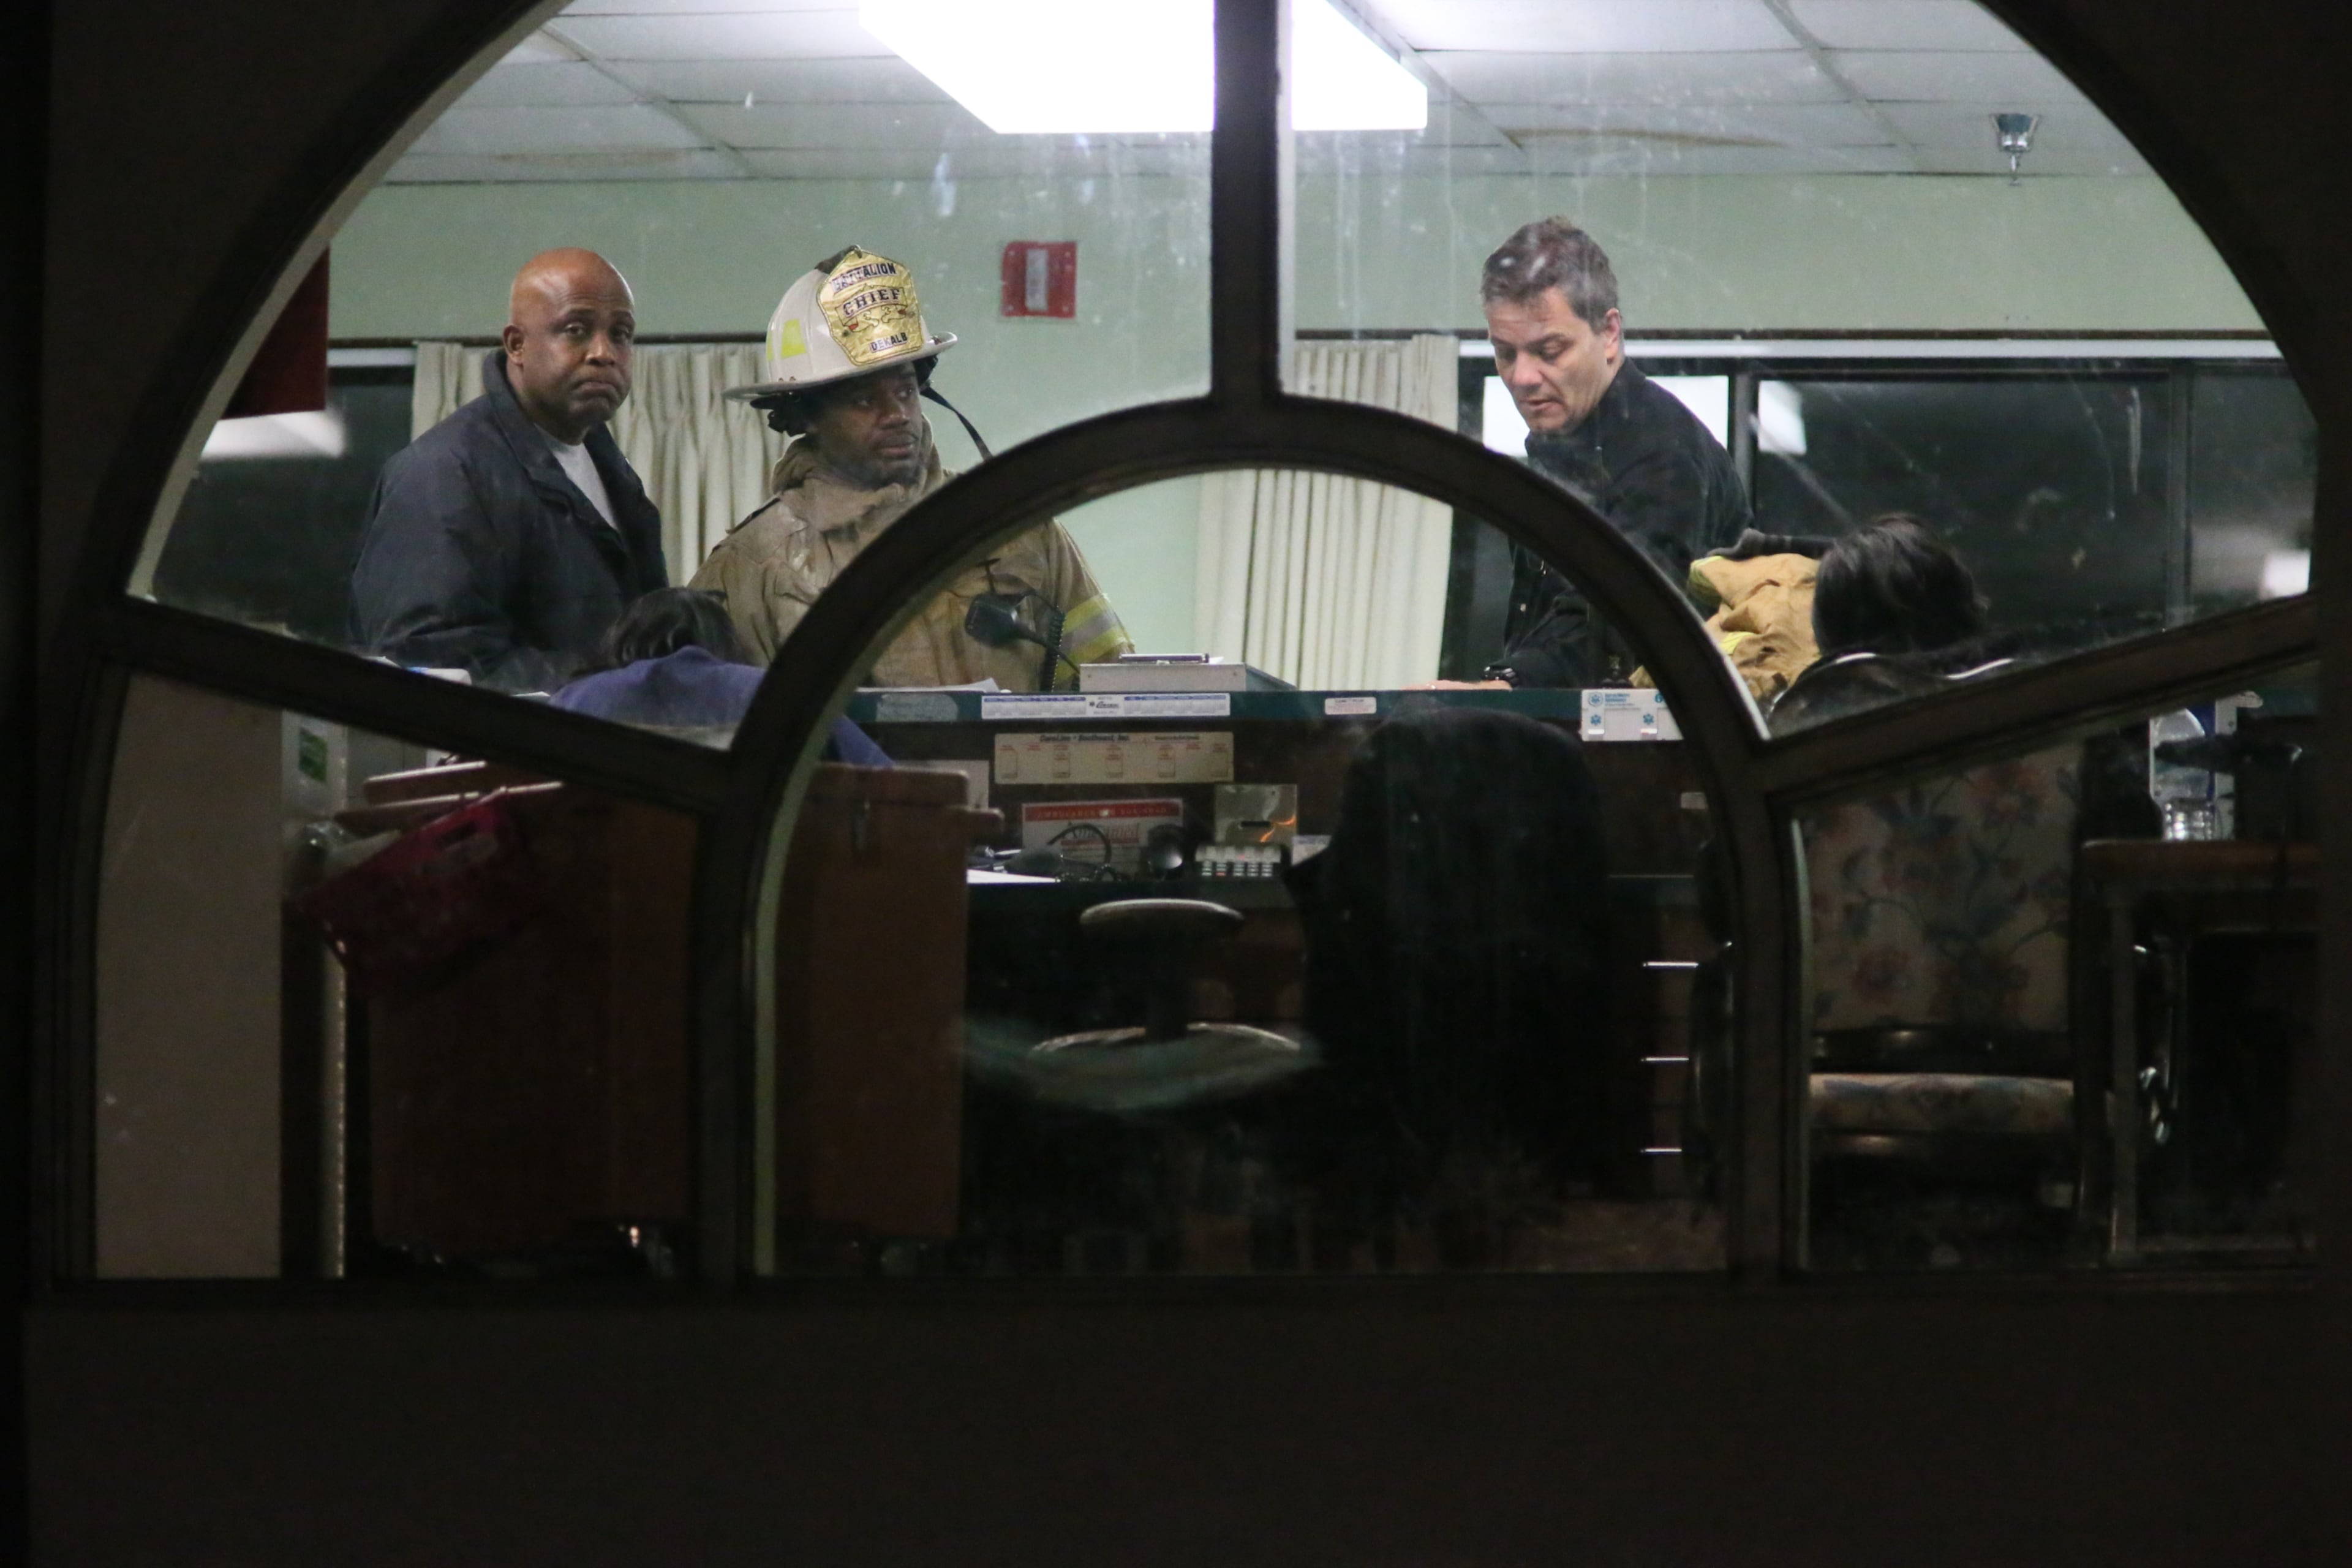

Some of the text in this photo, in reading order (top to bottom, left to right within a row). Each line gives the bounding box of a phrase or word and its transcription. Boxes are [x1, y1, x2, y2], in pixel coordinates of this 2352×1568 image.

[832, 262, 896, 291] BATTALION
[843, 289, 900, 316] CHIEF
[871, 332, 908, 351] DEKALB
